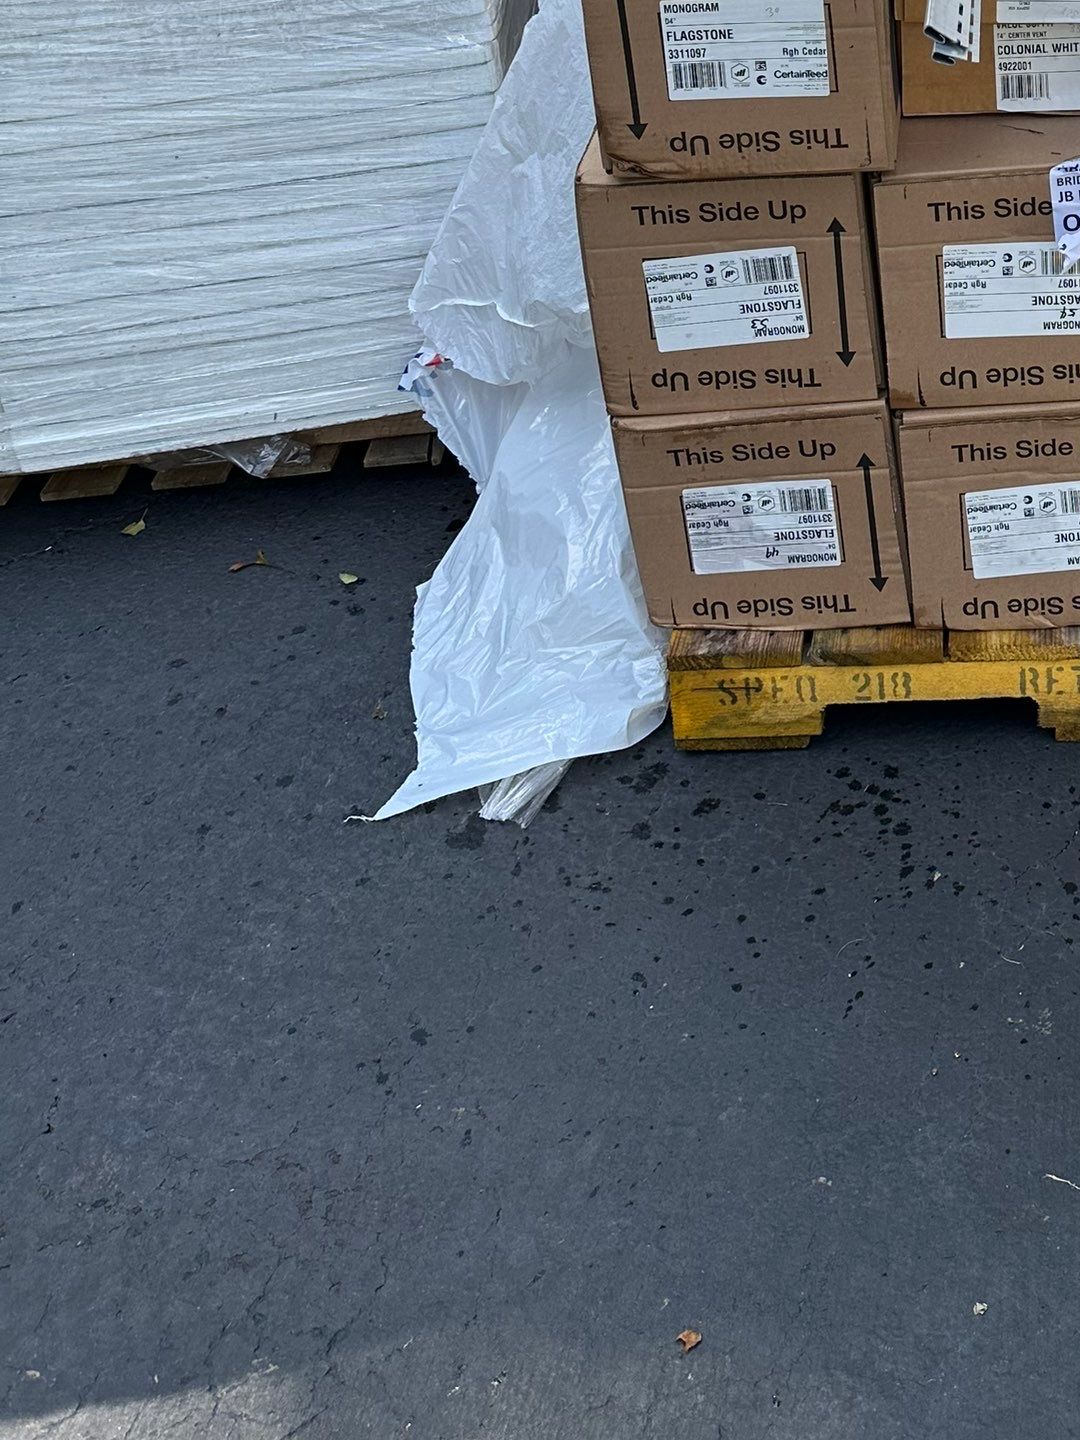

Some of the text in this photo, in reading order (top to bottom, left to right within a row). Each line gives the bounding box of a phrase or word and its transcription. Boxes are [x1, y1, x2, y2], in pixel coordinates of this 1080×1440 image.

[664, 3, 719, 14] MONOGRAM
[667, 29, 734, 41] FLAGSTONE
[668, 46, 826, 59] 3311097 Rgh Cedar
[997, 44, 1048, 56] COLONIAL
[998, 61, 1032, 72] 4922001
[774, 69, 828, 80] CertainTeed
[670, 128, 848, 156] This Side Up
[1058, 191, 1074, 202] JB
[631, 201, 806, 226] This Side Up
[927, 197, 1051, 222] This Side
[944, 259, 996, 268] CertainTeed
[646, 271, 698, 283] CertainTeed
[945, 281, 968, 289] Cedar
[970, 280, 986, 288] Rgh
[651, 283, 798, 303] 3311097 Rgh Cedar
[740, 299, 801, 314] FLAGSTONE
[755, 325, 805, 337] MONOGRAM
[651, 368, 822, 392] This Side Up
[940, 366, 978, 389] Up
[986, 366, 1044, 387] Side
[666, 440, 836, 467] This Side Up
[951, 443, 1007, 463] This
[1016, 439, 1073, 458] Side
[685, 500, 735, 510] CertainTeed
[967, 503, 1017, 514] CertainTeed
[689, 514, 832, 529] 3311097 Rgh Cedar
[994, 523, 1010, 532] Rgh
[970, 524, 991, 533] Cedar
[774, 530, 834, 541] FLAGSTONE
[787, 553, 837, 563] MONOGRAM
[692, 595, 856, 620] This Side Up
[963, 598, 999, 619] Up
[1008, 596, 1064, 615] Side
[852, 671, 913, 701] 218
